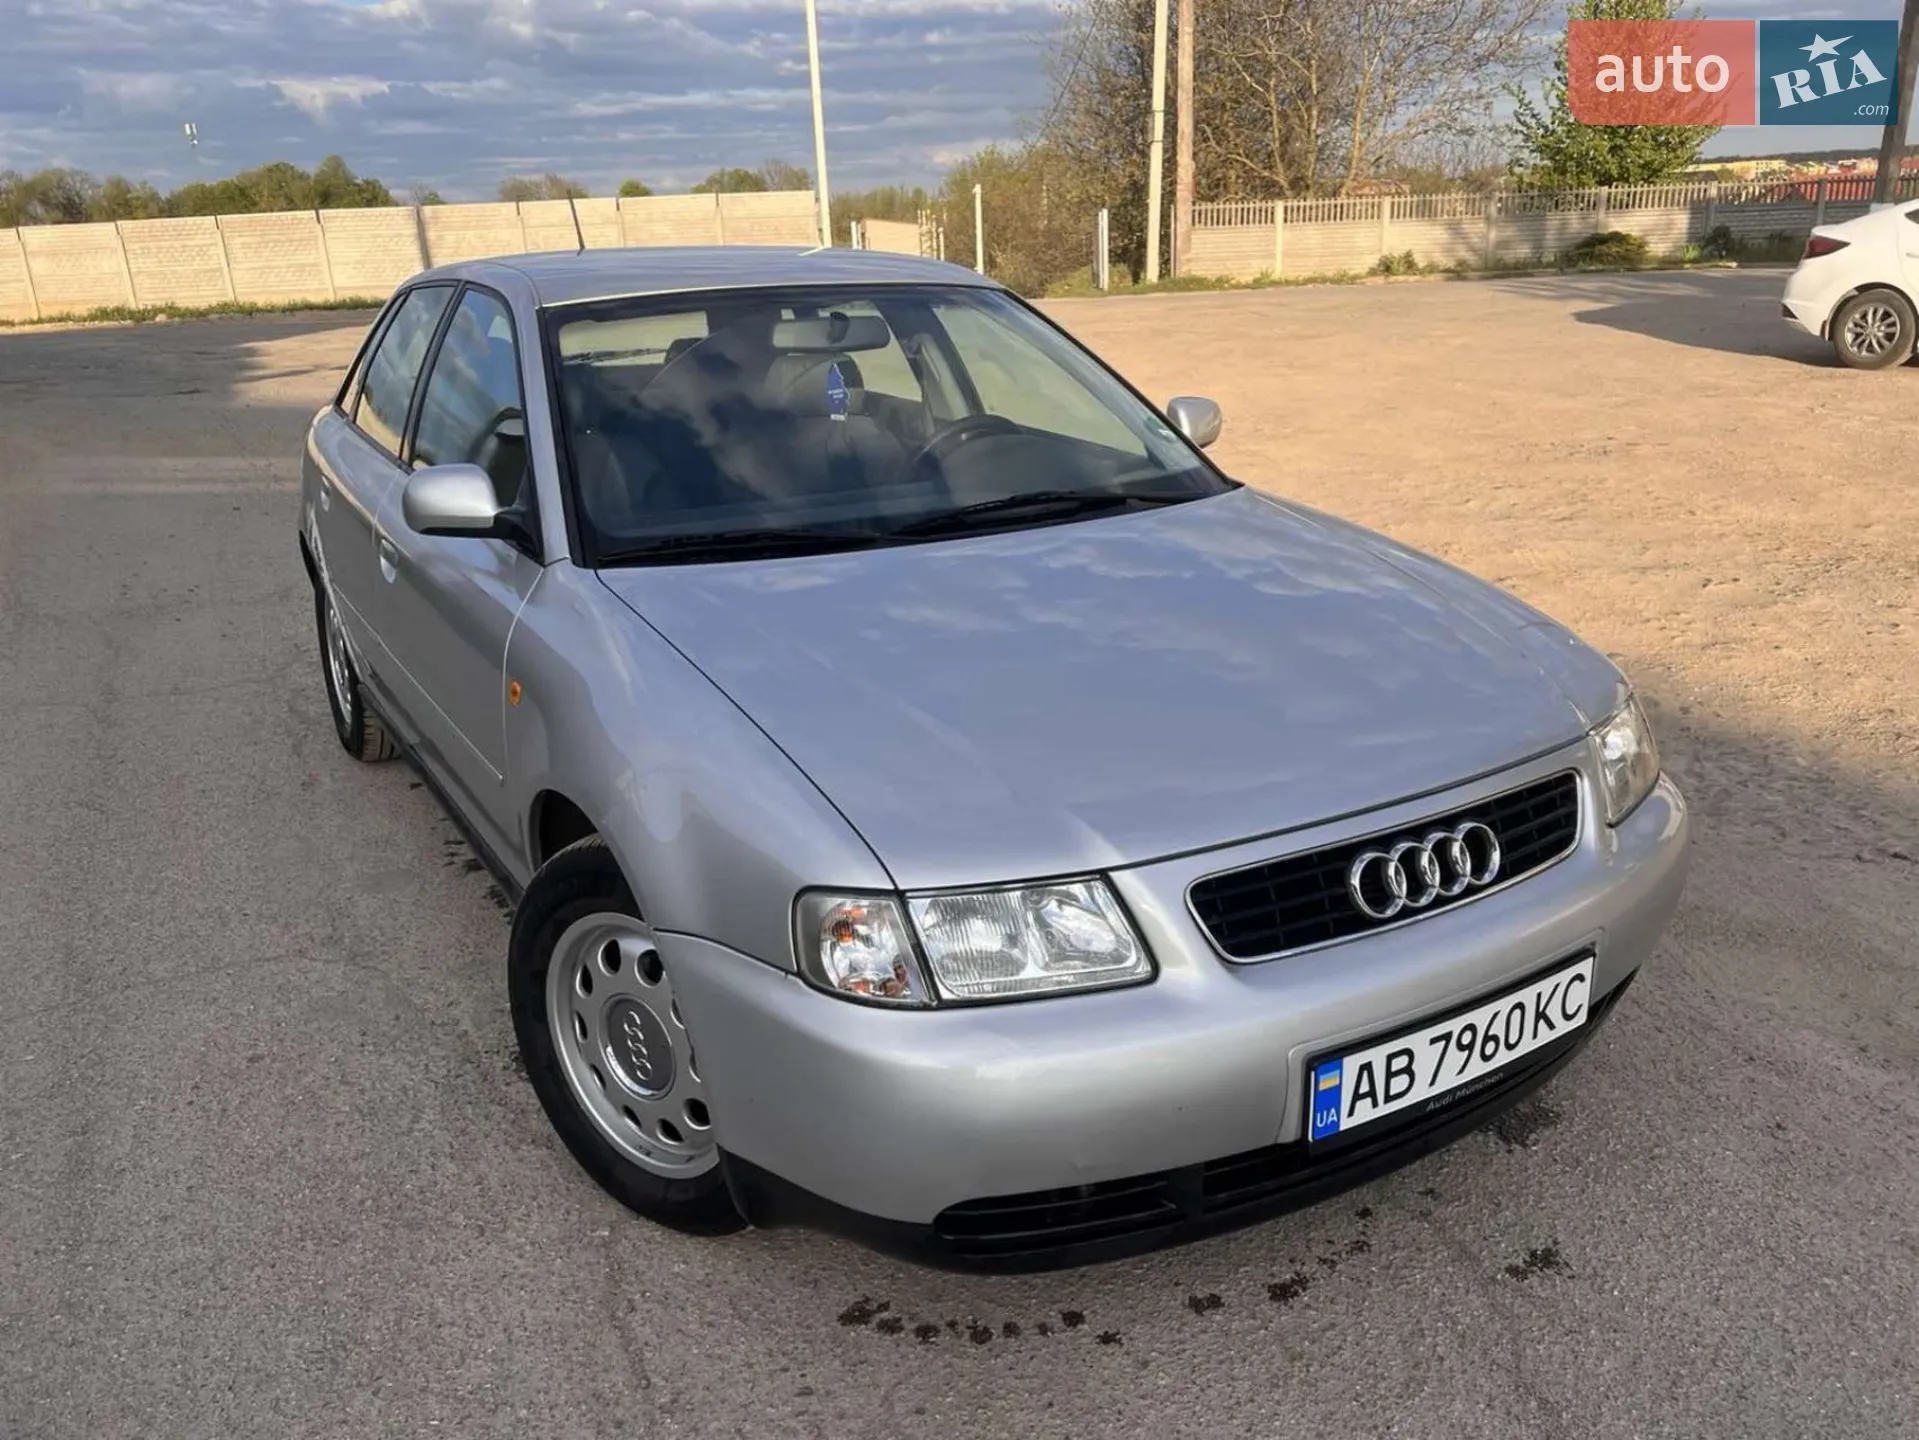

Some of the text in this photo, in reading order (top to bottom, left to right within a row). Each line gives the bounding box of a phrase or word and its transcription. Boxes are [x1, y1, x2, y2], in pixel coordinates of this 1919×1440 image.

[1346, 1047, 1416, 1119] AB
[1425, 1094, 1454, 1113] Audi
[1316, 1107, 1338, 1127] UA
